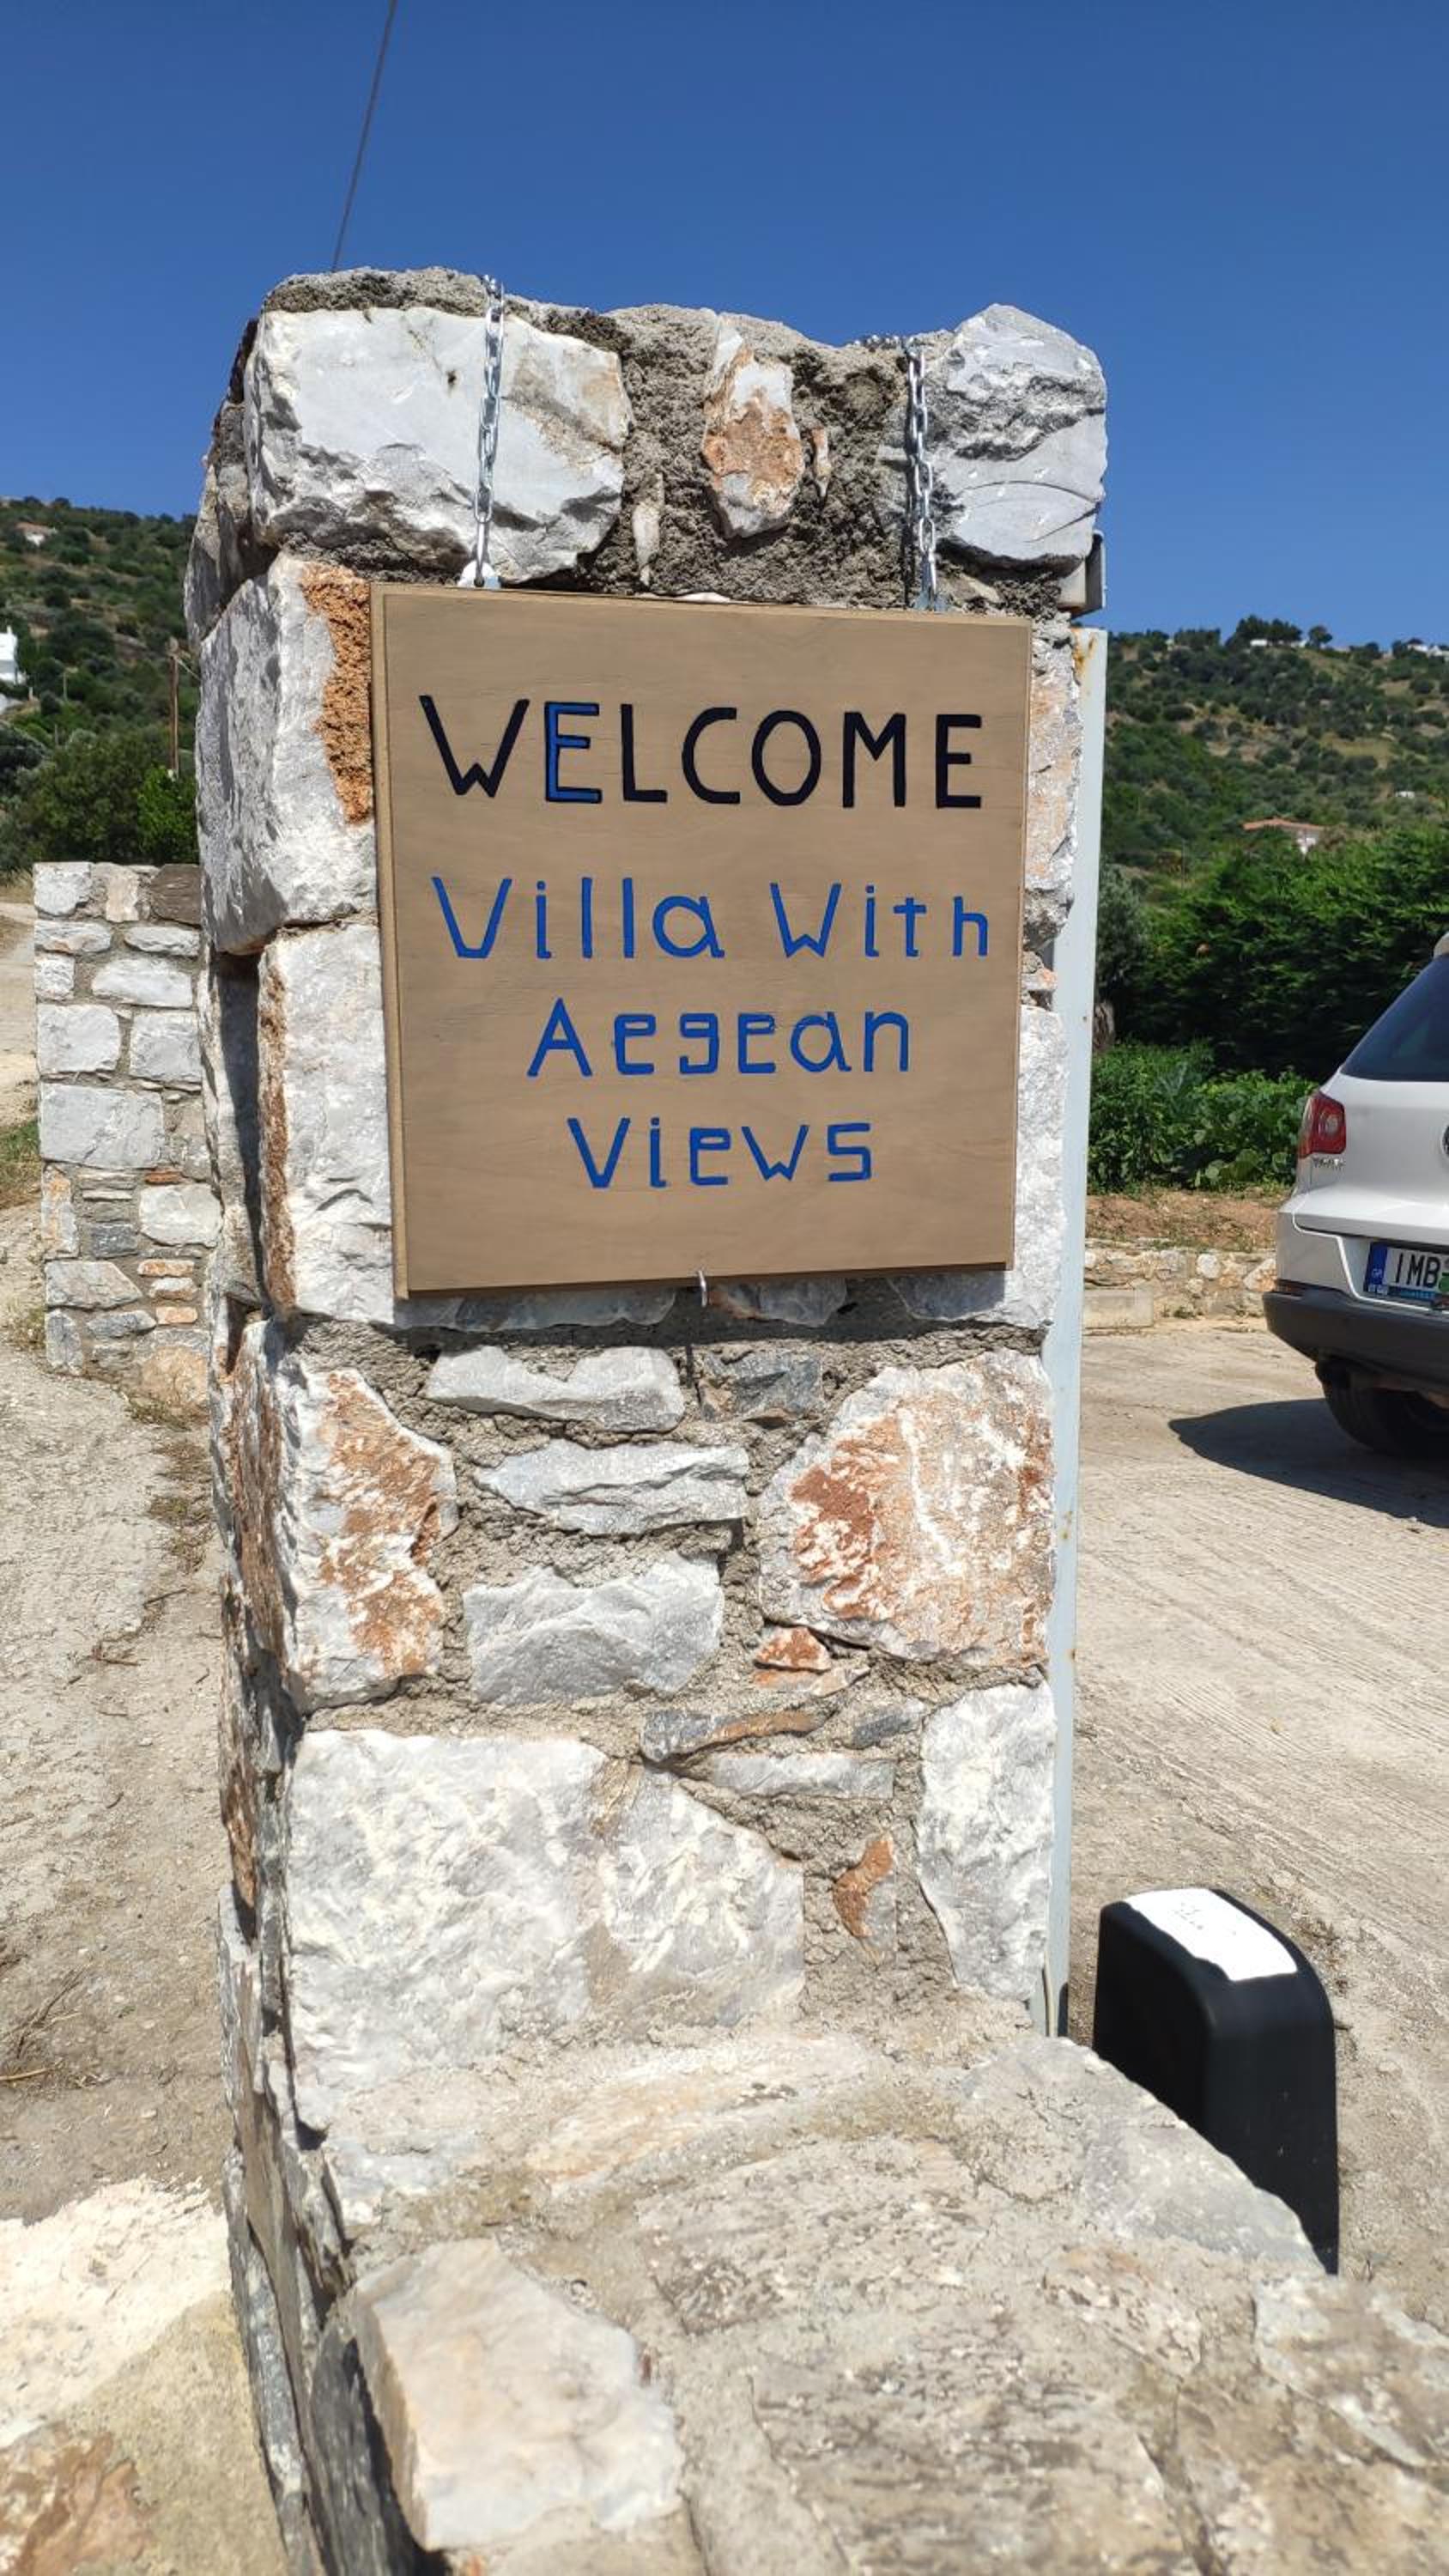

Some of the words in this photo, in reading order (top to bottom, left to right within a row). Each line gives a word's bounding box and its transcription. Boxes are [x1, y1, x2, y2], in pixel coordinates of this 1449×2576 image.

[418, 695, 982, 809] WELCOME
[431, 877, 725, 959] Villa
[769, 883, 988, 958] With
[527, 998, 910, 1078] Aegean
[567, 1117, 872, 1188] Views
